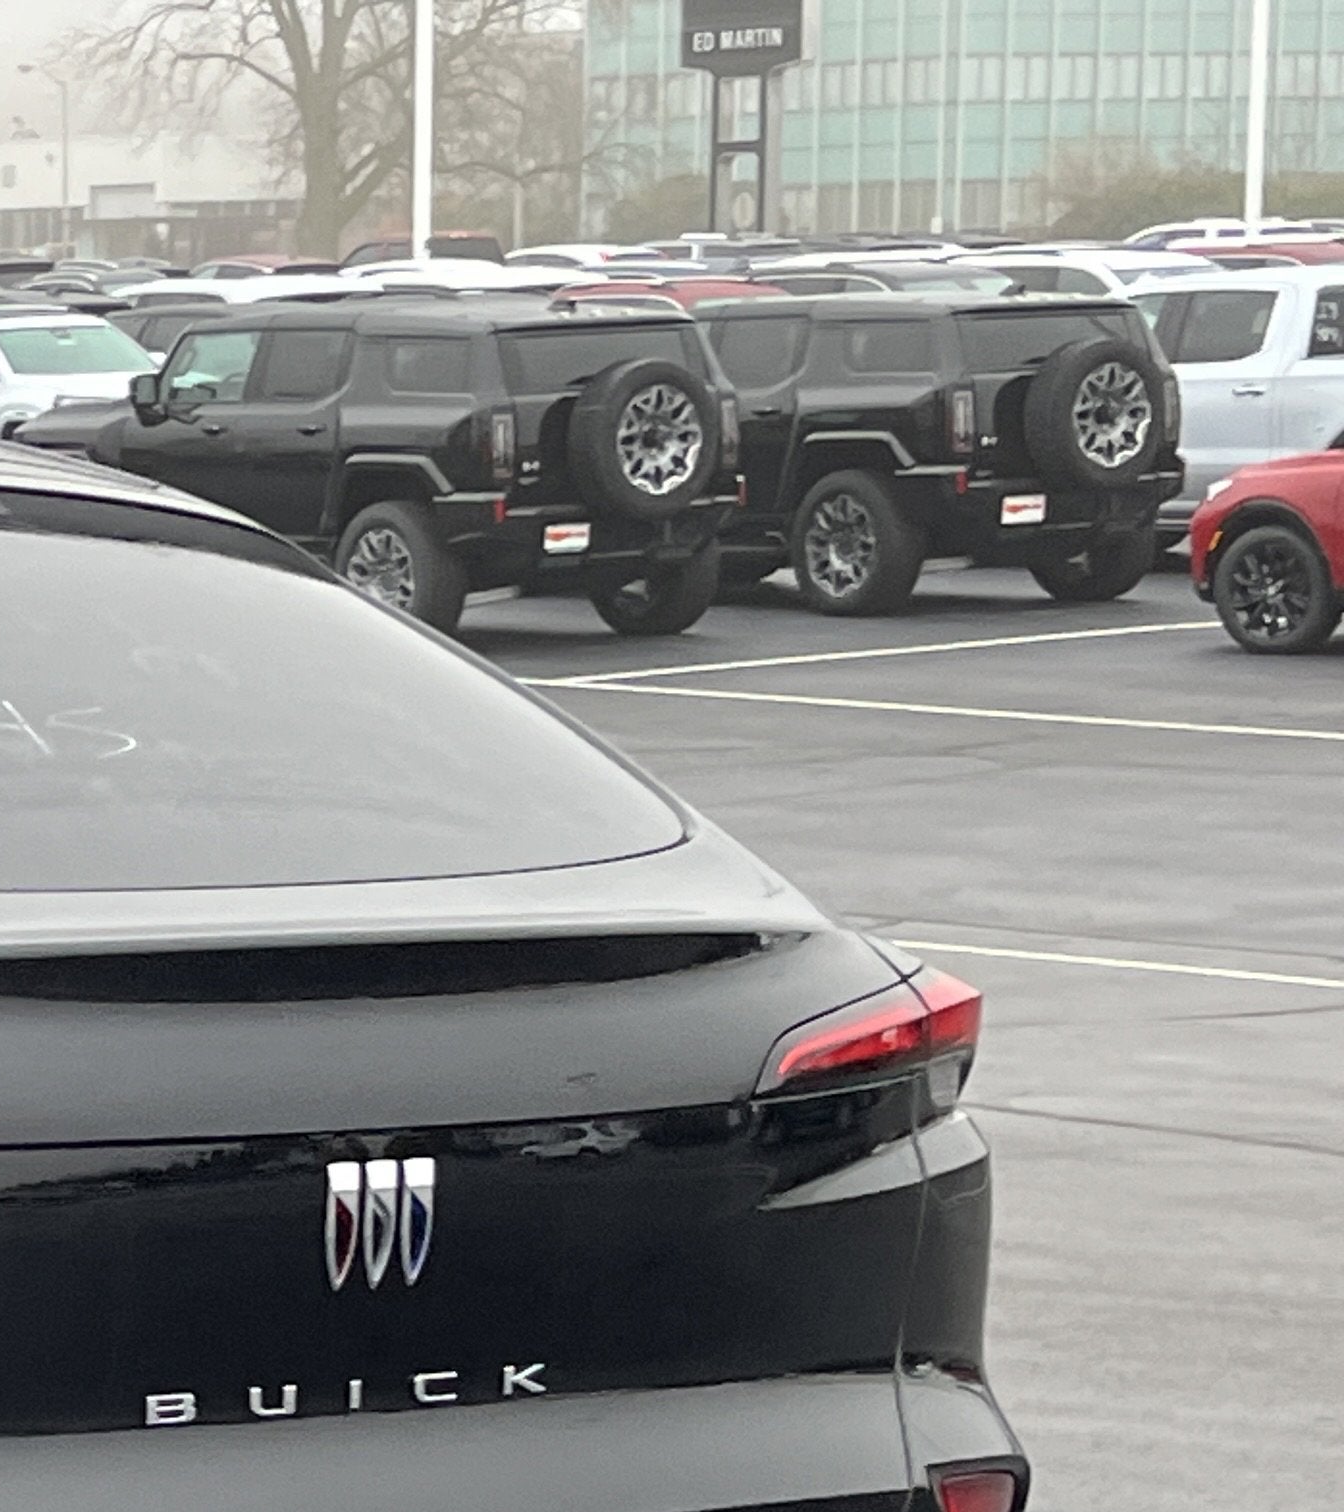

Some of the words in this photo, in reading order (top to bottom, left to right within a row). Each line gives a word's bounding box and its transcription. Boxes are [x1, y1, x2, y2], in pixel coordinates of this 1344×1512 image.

[692, 32, 714, 52] ED
[719, 27, 783, 50] MARTIN
[145, 1363, 547, 1426] BUICK
